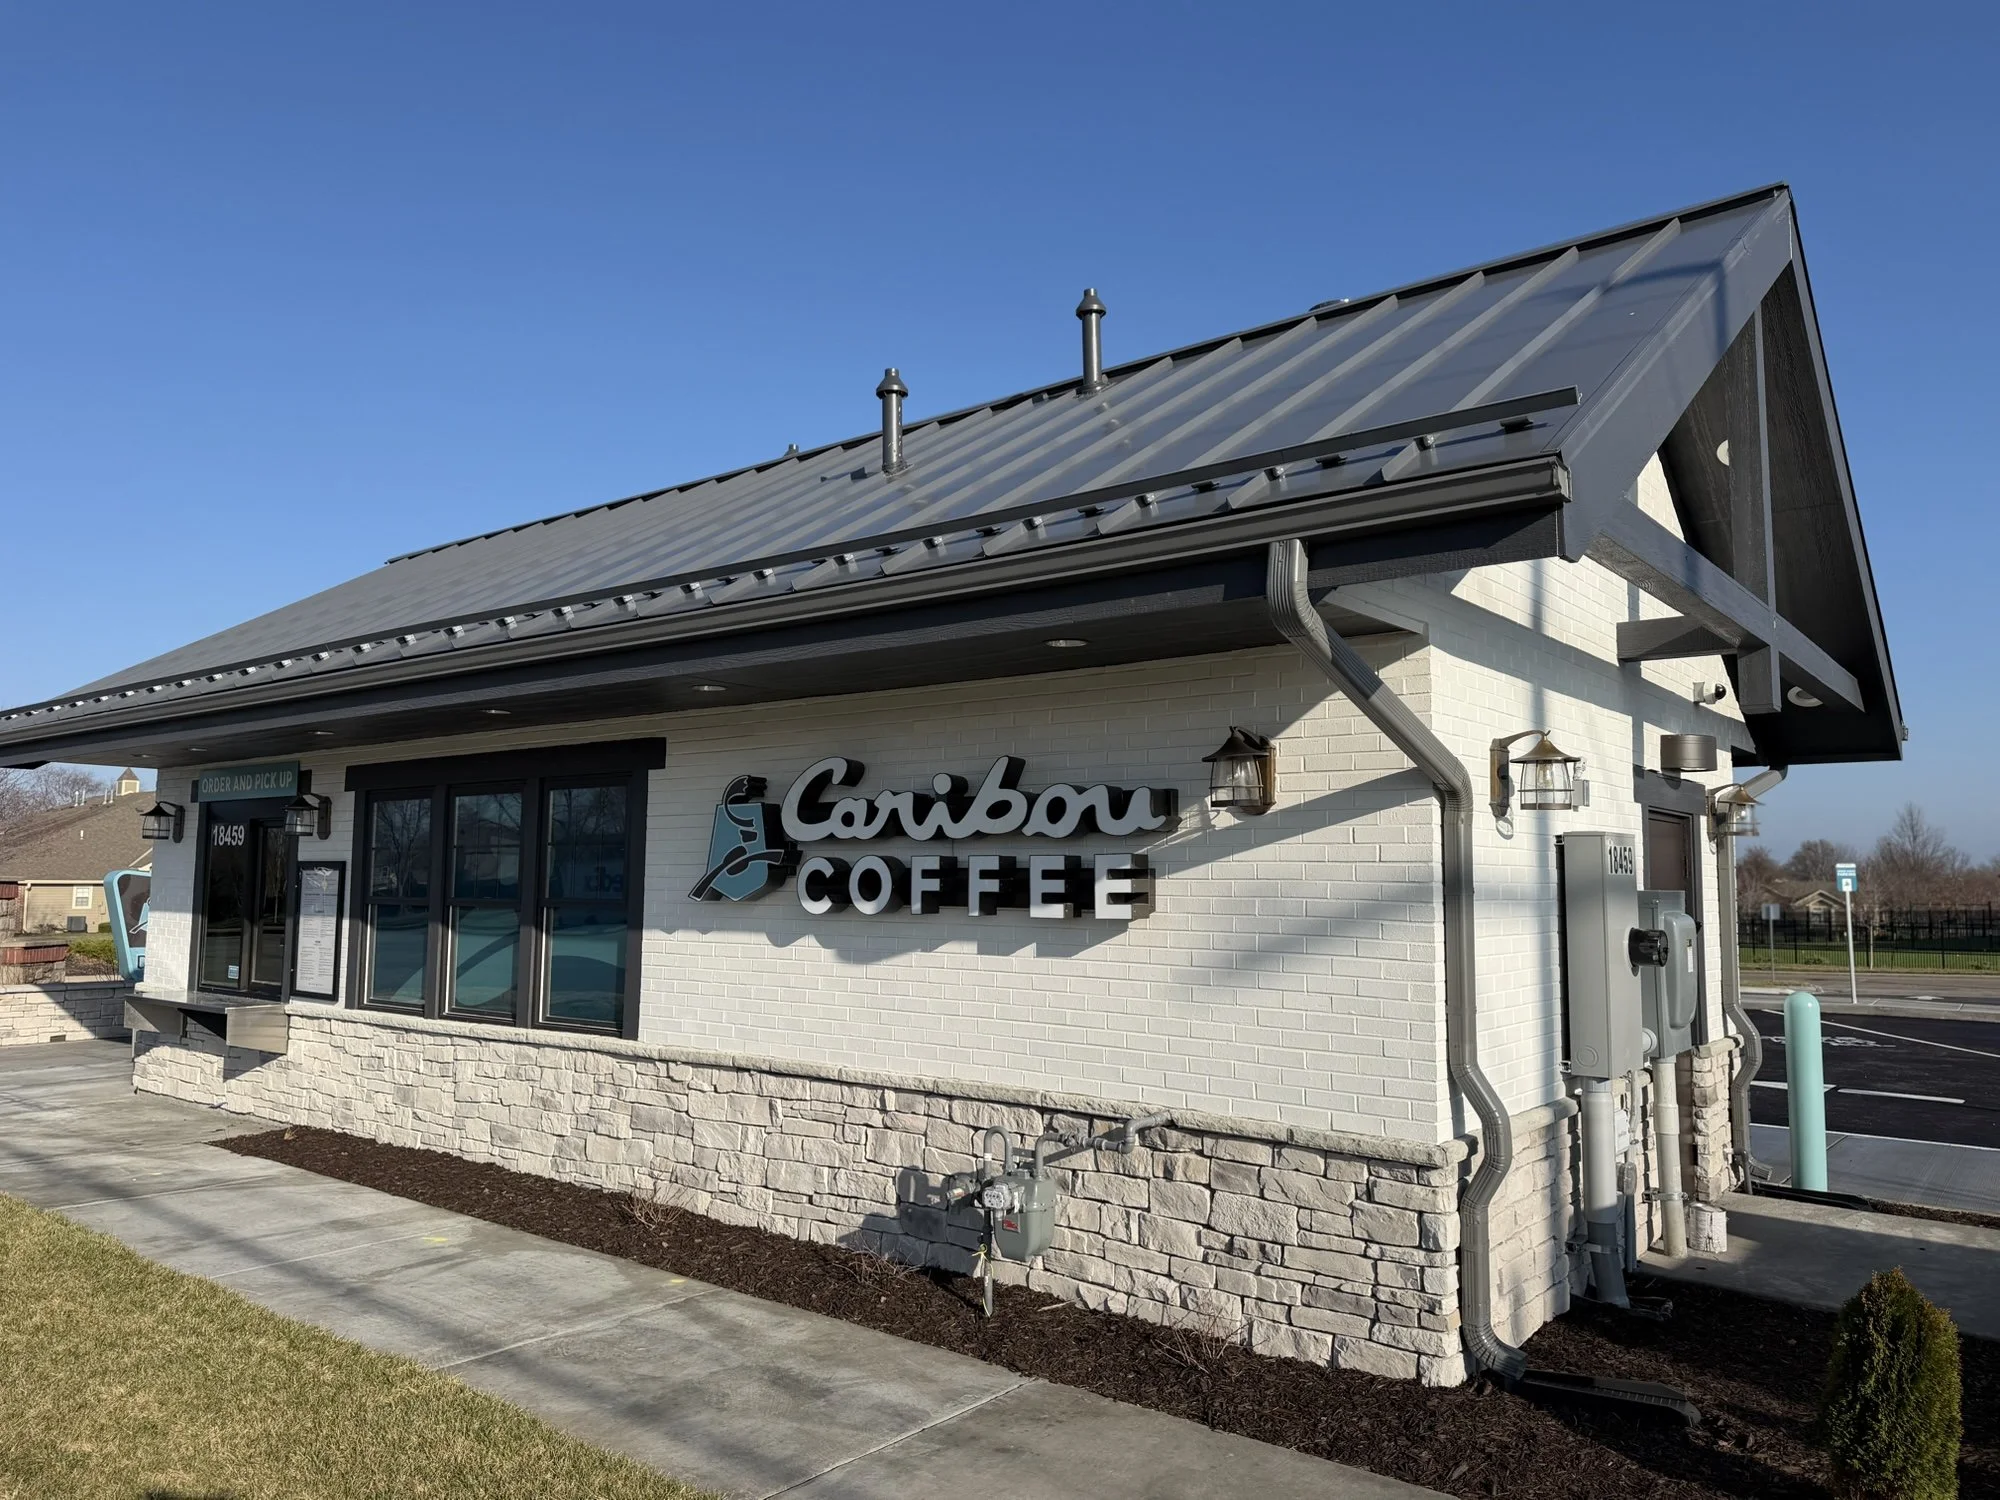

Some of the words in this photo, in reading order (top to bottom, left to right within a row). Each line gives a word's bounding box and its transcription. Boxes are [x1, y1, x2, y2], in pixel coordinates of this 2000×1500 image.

[201, 776, 231, 793] ORDER
[233, 774, 252, 791] AND
[254, 771, 277, 789] PICK
[279, 770, 293, 788] UP
[780, 755, 1171, 842] Caribou
[212, 824, 245, 847] 18459
[1608, 845, 1633, 875] 18459
[796, 853, 1137, 920] COFFEE
